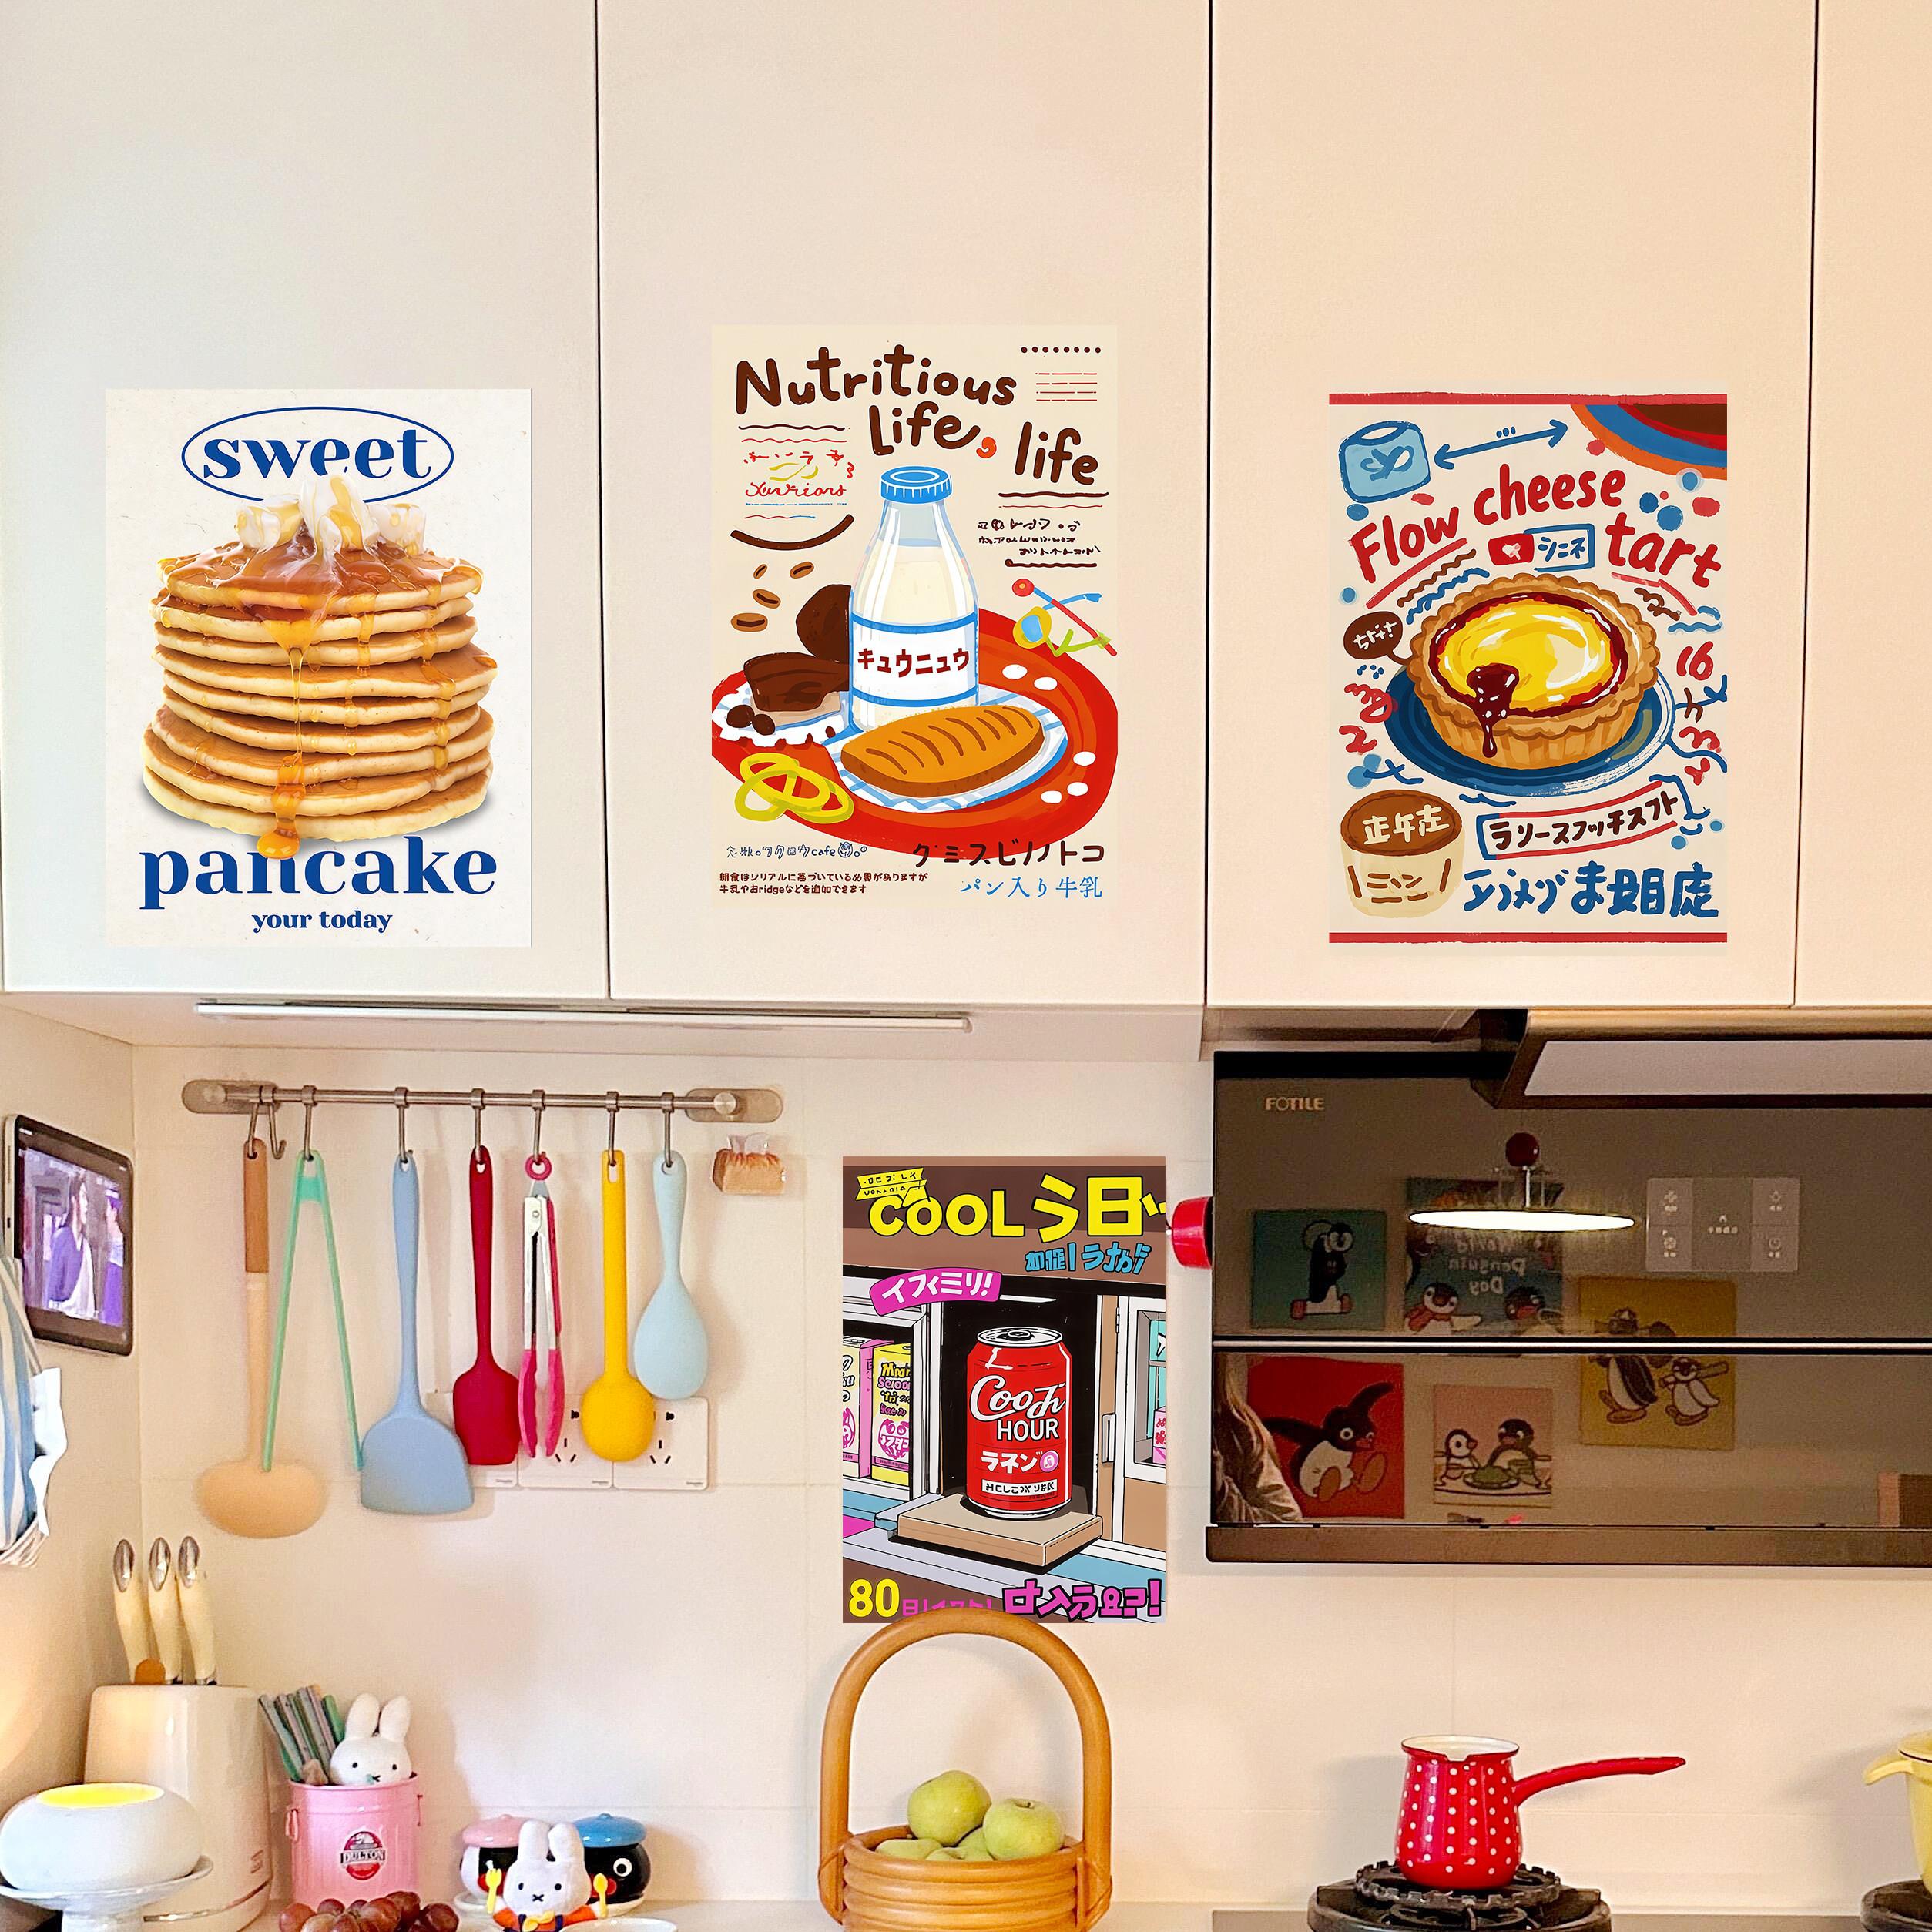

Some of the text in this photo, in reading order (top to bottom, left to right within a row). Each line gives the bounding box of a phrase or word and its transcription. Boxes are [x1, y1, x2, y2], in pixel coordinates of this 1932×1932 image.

[735, 344, 1018, 415] Nutritious
[203, 429, 431, 478] sweet
[1014, 421, 1099, 486] life
[1350, 463, 1722, 589] Flow cheese tart
[857, 647, 970, 679] キュウニュウ
[139, 836, 498, 910] pancake
[960, 876, 1102, 898] パン入り牛乳
[252, 910, 393, 934] your today
[1265, 1096, 1325, 1111] FOTILE
[869, 1189, 1025, 1236] COOL
[997, 1417, 1059, 1442] HOUR
[849, 1578, 900, 1617] 80
[343, 1850, 384, 1863] DULTON
